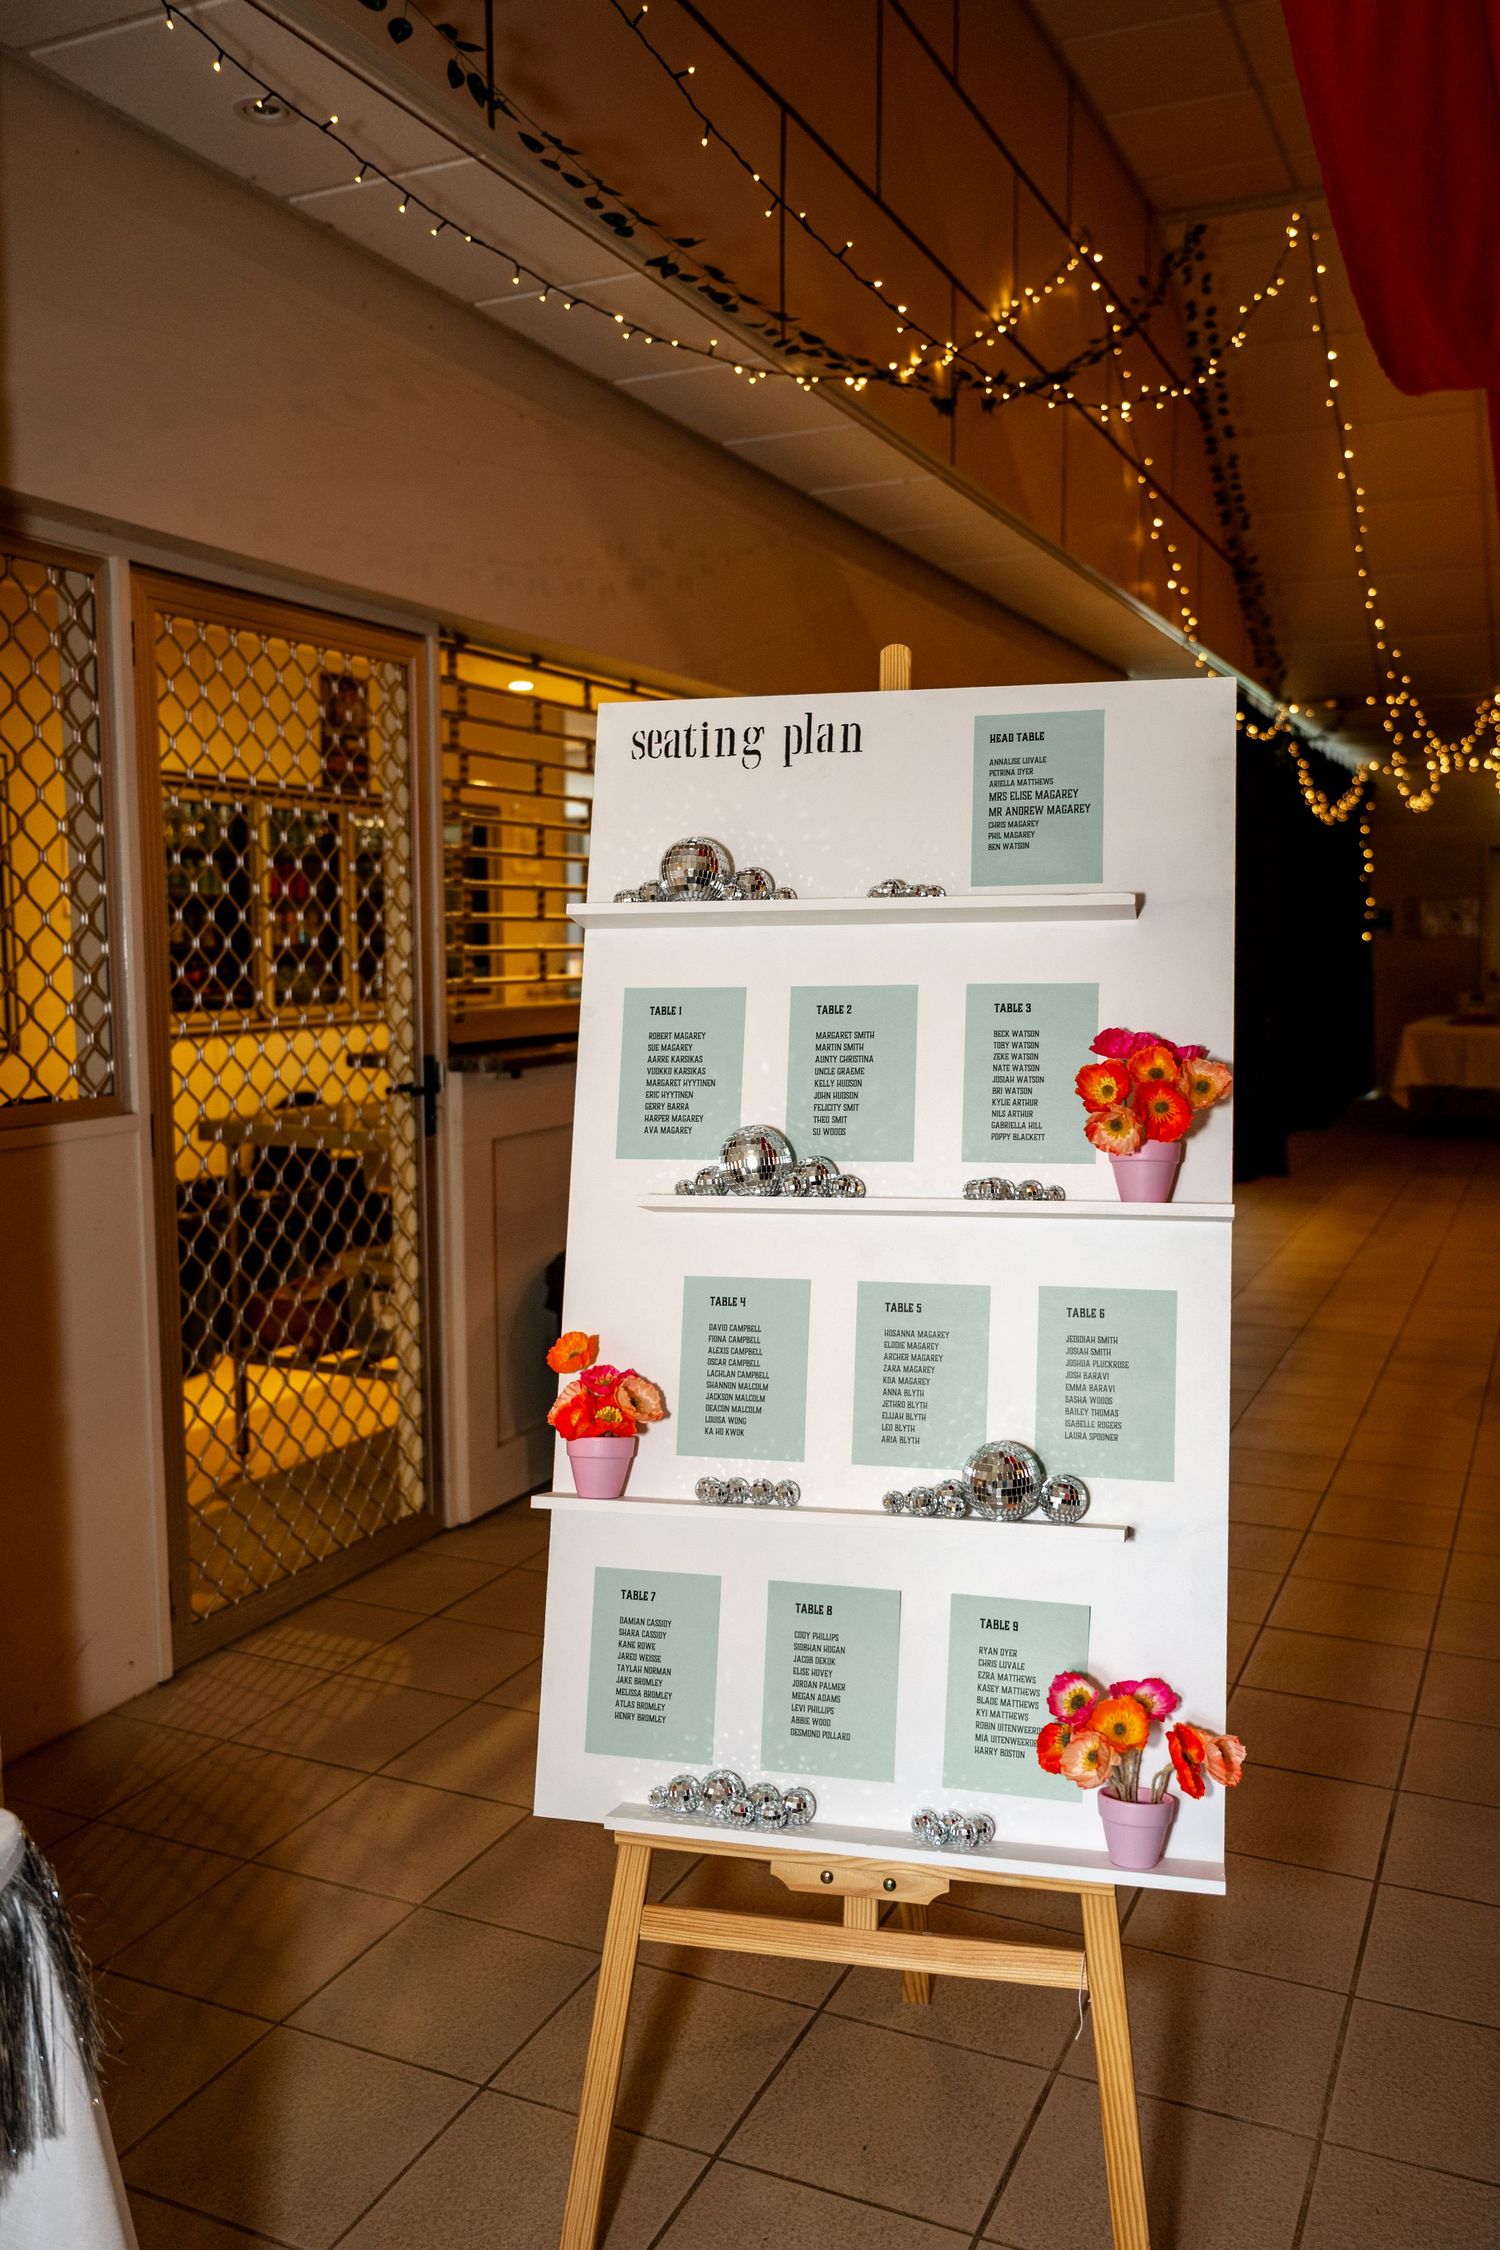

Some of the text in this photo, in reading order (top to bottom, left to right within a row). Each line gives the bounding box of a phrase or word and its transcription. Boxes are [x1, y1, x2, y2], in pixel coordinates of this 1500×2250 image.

[631, 712, 863, 770] seating plan
[990, 731, 1045, 743] HEAD TABLE
[989, 756, 1047, 766] ANNALISE LUVALE
[989, 778, 1054, 788] ARIELLA MATTHEWS
[989, 788, 1079, 802] MRS ELISE MAGAREY
[989, 803, 1091, 817] MR ANDREW MAGAREY
[988, 831, 1036, 840] PHIL MAGAREY
[988, 842, 1030, 851] BEN WATSON
[650, 1006, 682, 1016] TABLE 1
[816, 1004, 852, 1015] TABLE 2
[994, 1003, 1032, 1013] TABLE 3
[648, 1032, 706, 1040] ROBERT MAGAREY
[816, 1031, 875, 1040] MARGARET SMITH
[647, 1043, 693, 1052] SUE MAGAREY
[815, 1043, 864, 1051] MARTIN SMITH
[815, 1055, 874, 1064] AUNTY CHRISTINA
[993, 1053, 1039, 1061] ZEKE WATSON
[814, 1067, 865, 1076] UNCLE GRAEME
[992, 1064, 1040, 1072] NATE WATSON
[646, 1079, 716, 1087] MARGARET HYYTINEN
[814, 1079, 863, 1088] KELLY HUDSON
[992, 1076, 1045, 1084] JOSIAH WATSON
[645, 1091, 694, 1099] ERIC HYYTINEN
[992, 1087, 1033, 1095] BRI WATSON
[645, 1102, 690, 1111] GERRY BARRA
[813, 1103, 860, 1112] FELICITY SMIT
[991, 1098, 1039, 1107] KYLIE ARTHUR
[992, 1110, 1034, 1118] NILS ARTHUR
[644, 1126, 693, 1135] AVA MAGAREY
[991, 1132, 1046, 1141] POPPY BLACKETT
[710, 1296, 746, 1307] TABLE 4
[885, 1302, 922, 1313] TABLE 5
[1066, 1307, 1105, 1319] TABLE 6
[884, 1329, 950, 1339] HOSANNA MAGAREY
[708, 1335, 761, 1344] FIONA CAMPBELL
[707, 1346, 763, 1356] ALEXIS CAMPBELL
[883, 1352, 943, 1362] ARCHER MAGAREY
[883, 1364, 936, 1374] ZARA MAGAREY
[707, 1369, 770, 1380] LACHLAN CAMPBELL
[1065, 1371, 1110, 1380] JOSH BARAVI
[706, 1381, 769, 1391] SHANNON MALCOLM
[883, 1376, 931, 1386] KOA MAGAREY
[882, 1388, 925, 1397] ANNA BLYTH
[1065, 1383, 1116, 1393] EMMA BARAVI
[705, 1392, 766, 1403] JACKSON MALCOLM
[1065, 1395, 1113, 1405] SASHA WOODS
[705, 1404, 762, 1414] DEACON MALCOLM
[882, 1400, 928, 1409] JETHRO BLYTH
[1065, 1407, 1119, 1418] BAILEY THOMAS
[705, 1415, 747, 1425] LOUISA WONG
[881, 1435, 920, 1445] ARIA BLYTH
[1064, 1432, 1119, 1442] LAURA SPOONER
[621, 1589, 656, 1602] TABLE 7
[795, 1603, 833, 1616] TABLE 8
[619, 1616, 672, 1628] DAMIAN CASSIDY
[980, 1618, 1019, 1632] TABLE 9
[794, 1642, 846, 1654] SIOBHAN HOGAN
[979, 1646, 1018, 1658] RYAN DYER
[617, 1663, 672, 1676] TAYLAH NORMAN
[978, 1658, 1025, 1671] CHRIS LUVALE
[793, 1667, 833, 1678] ELISE HOVEY
[616, 1676, 663, 1687] JAKE BROMLEY
[977, 1671, 1037, 1685] EZRA MATTHEWS
[792, 1679, 846, 1691] JORDAN PALMER
[977, 1683, 1041, 1697] KASEY MATTHEWS
[615, 1687, 673, 1700] MELISSA BROMLEY
[792, 1691, 841, 1703] MEGAN ADAMS
[615, 1699, 666, 1711] ATLAS BROMLEY
[976, 1695, 1039, 1709] BLADE MATTHEWS
[791, 1703, 835, 1715] LEVI PHILLIPS
[614, 1711, 666, 1724] HENRY BROMLEY
[976, 1708, 1029, 1722] KYI MATTHEWS
[790, 1728, 851, 1741] DESMOND POLLARD
[974, 1745, 1025, 1759] HARRY BOSTON
